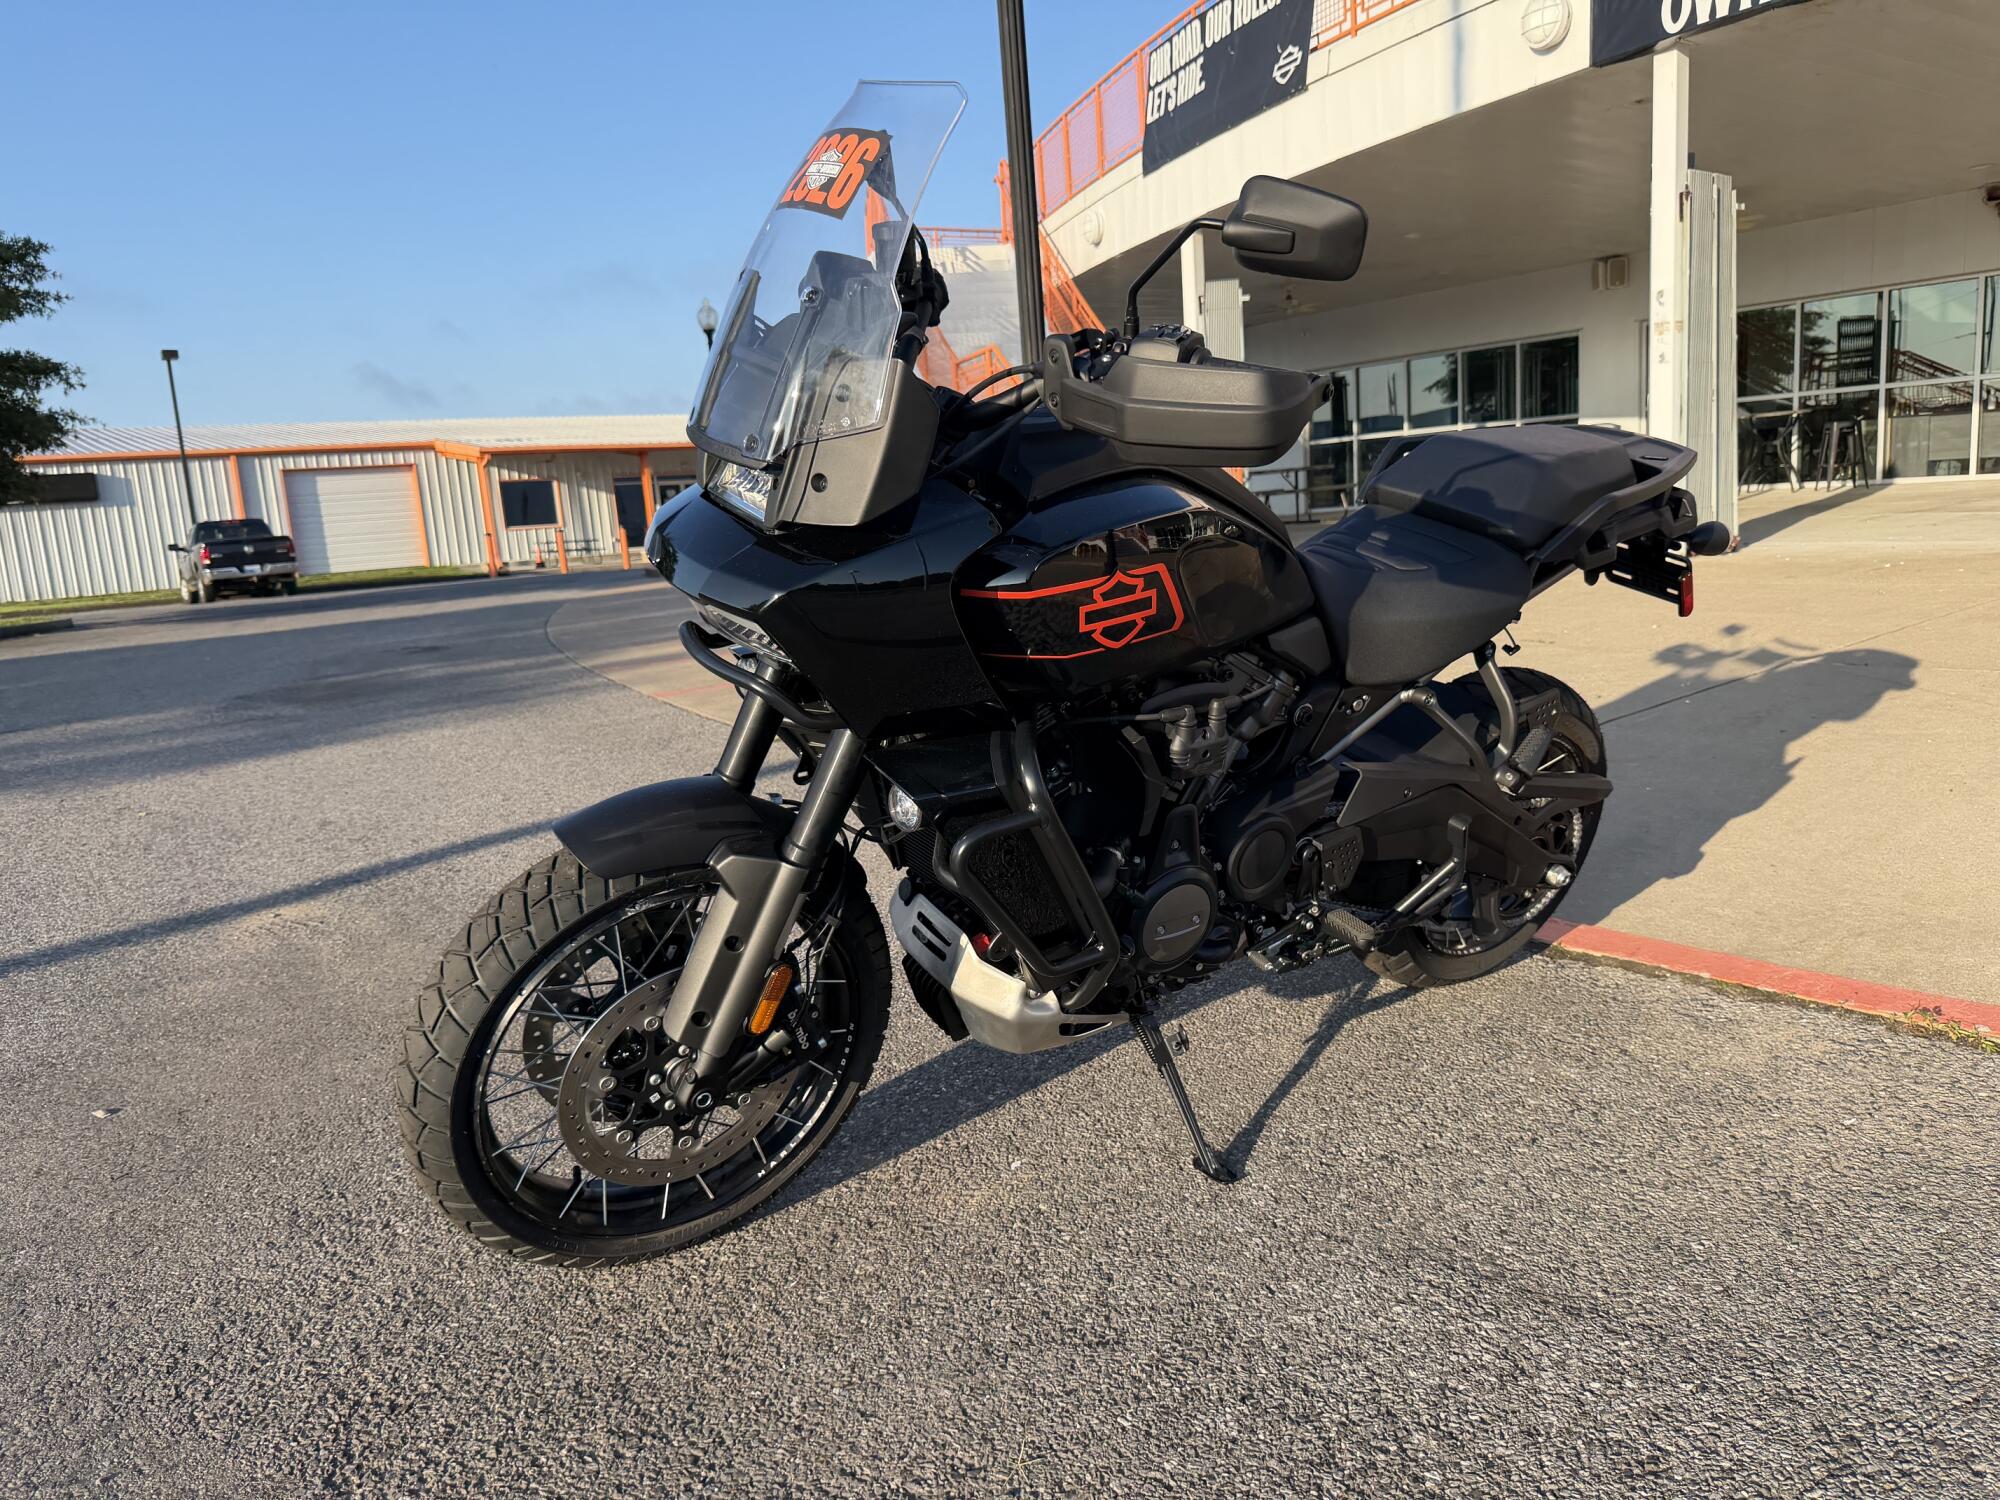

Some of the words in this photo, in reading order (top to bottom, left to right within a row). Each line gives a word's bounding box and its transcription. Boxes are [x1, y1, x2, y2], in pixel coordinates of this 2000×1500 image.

[1149, 41, 1171, 87] OUR
[1171, 18, 1204, 73] ROAD.
[1205, 0, 1232, 48] OUR
[1146, 75, 1178, 125] LET'S
[1177, 56, 1205, 107] RIDE.
[780, 133, 880, 209] 2026
